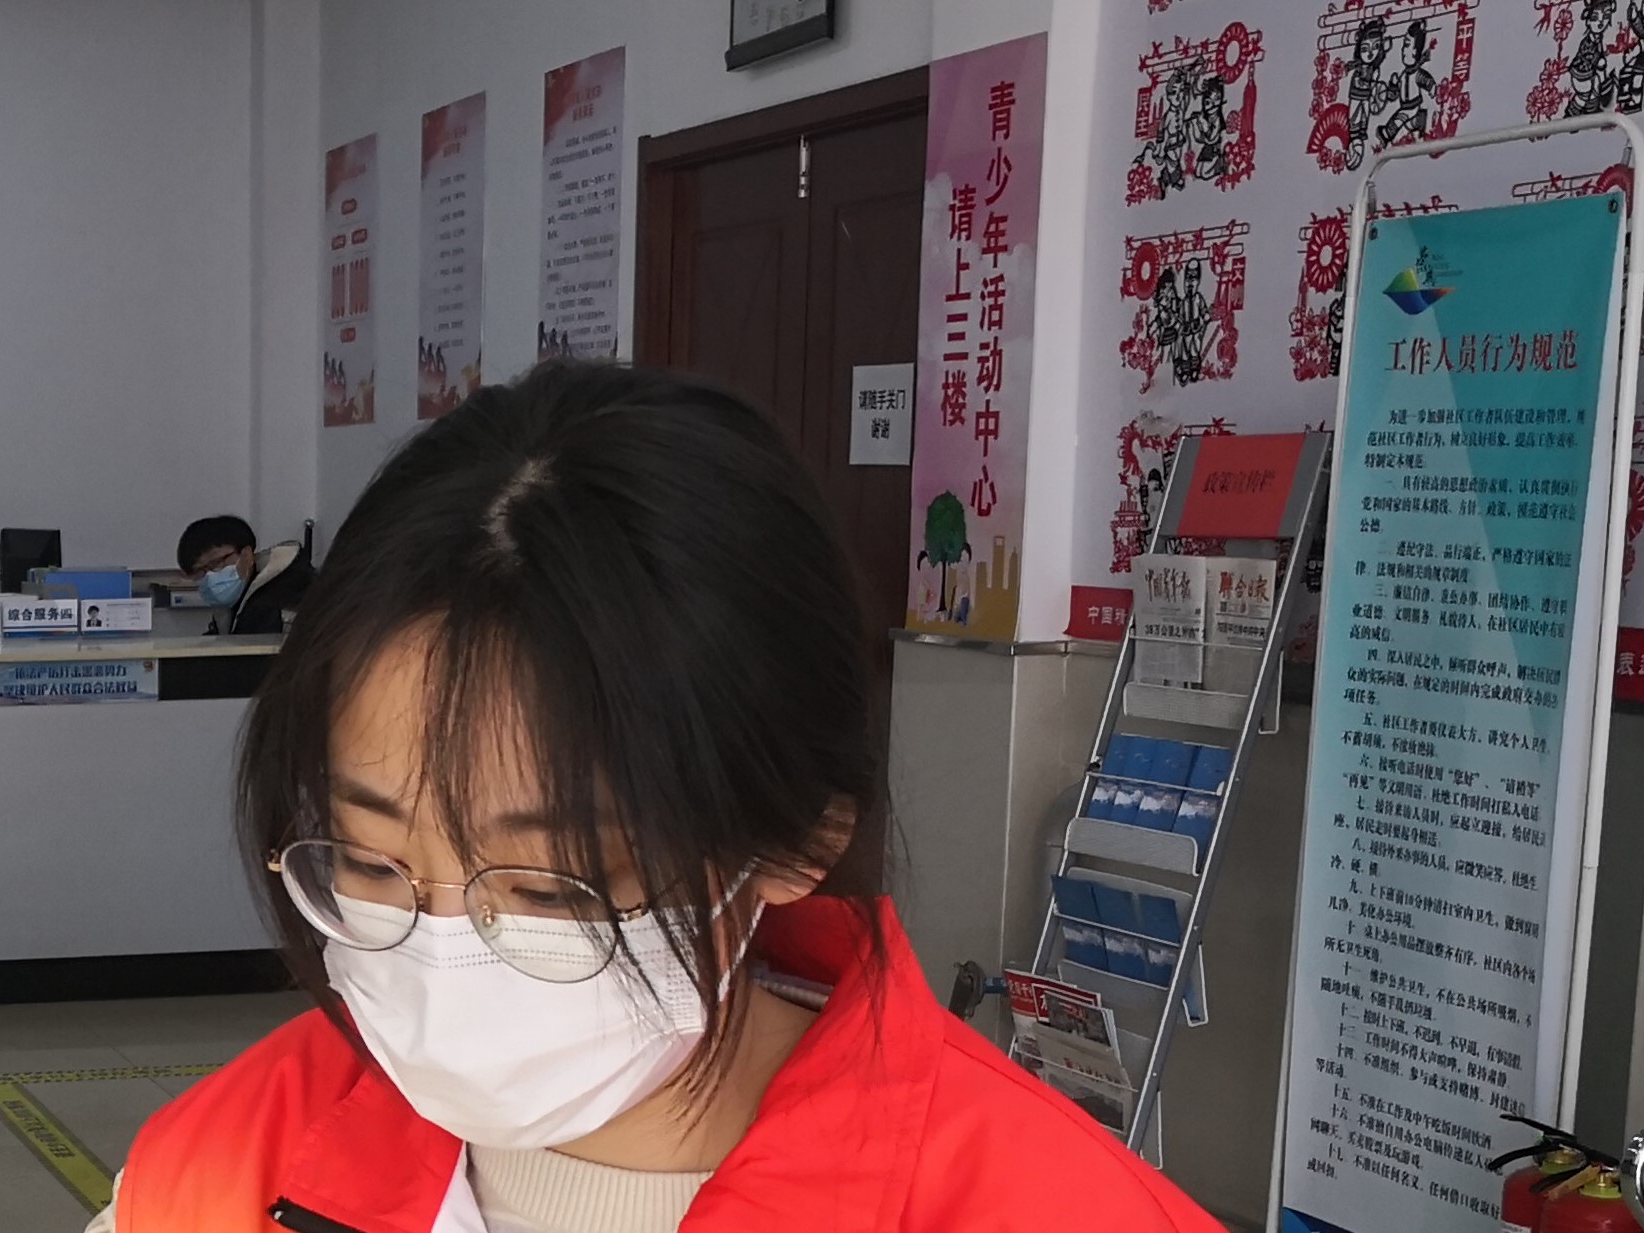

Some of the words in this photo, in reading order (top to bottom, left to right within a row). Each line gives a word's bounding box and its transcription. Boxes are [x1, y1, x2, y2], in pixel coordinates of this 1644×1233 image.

[940, 184, 977, 428] 请上三楼
[970, 80, 1016, 518] 青少年活动中心
[1385, 329, 1579, 375] 工作人员行为规范
[859, 389, 905, 410] 请随手关门
